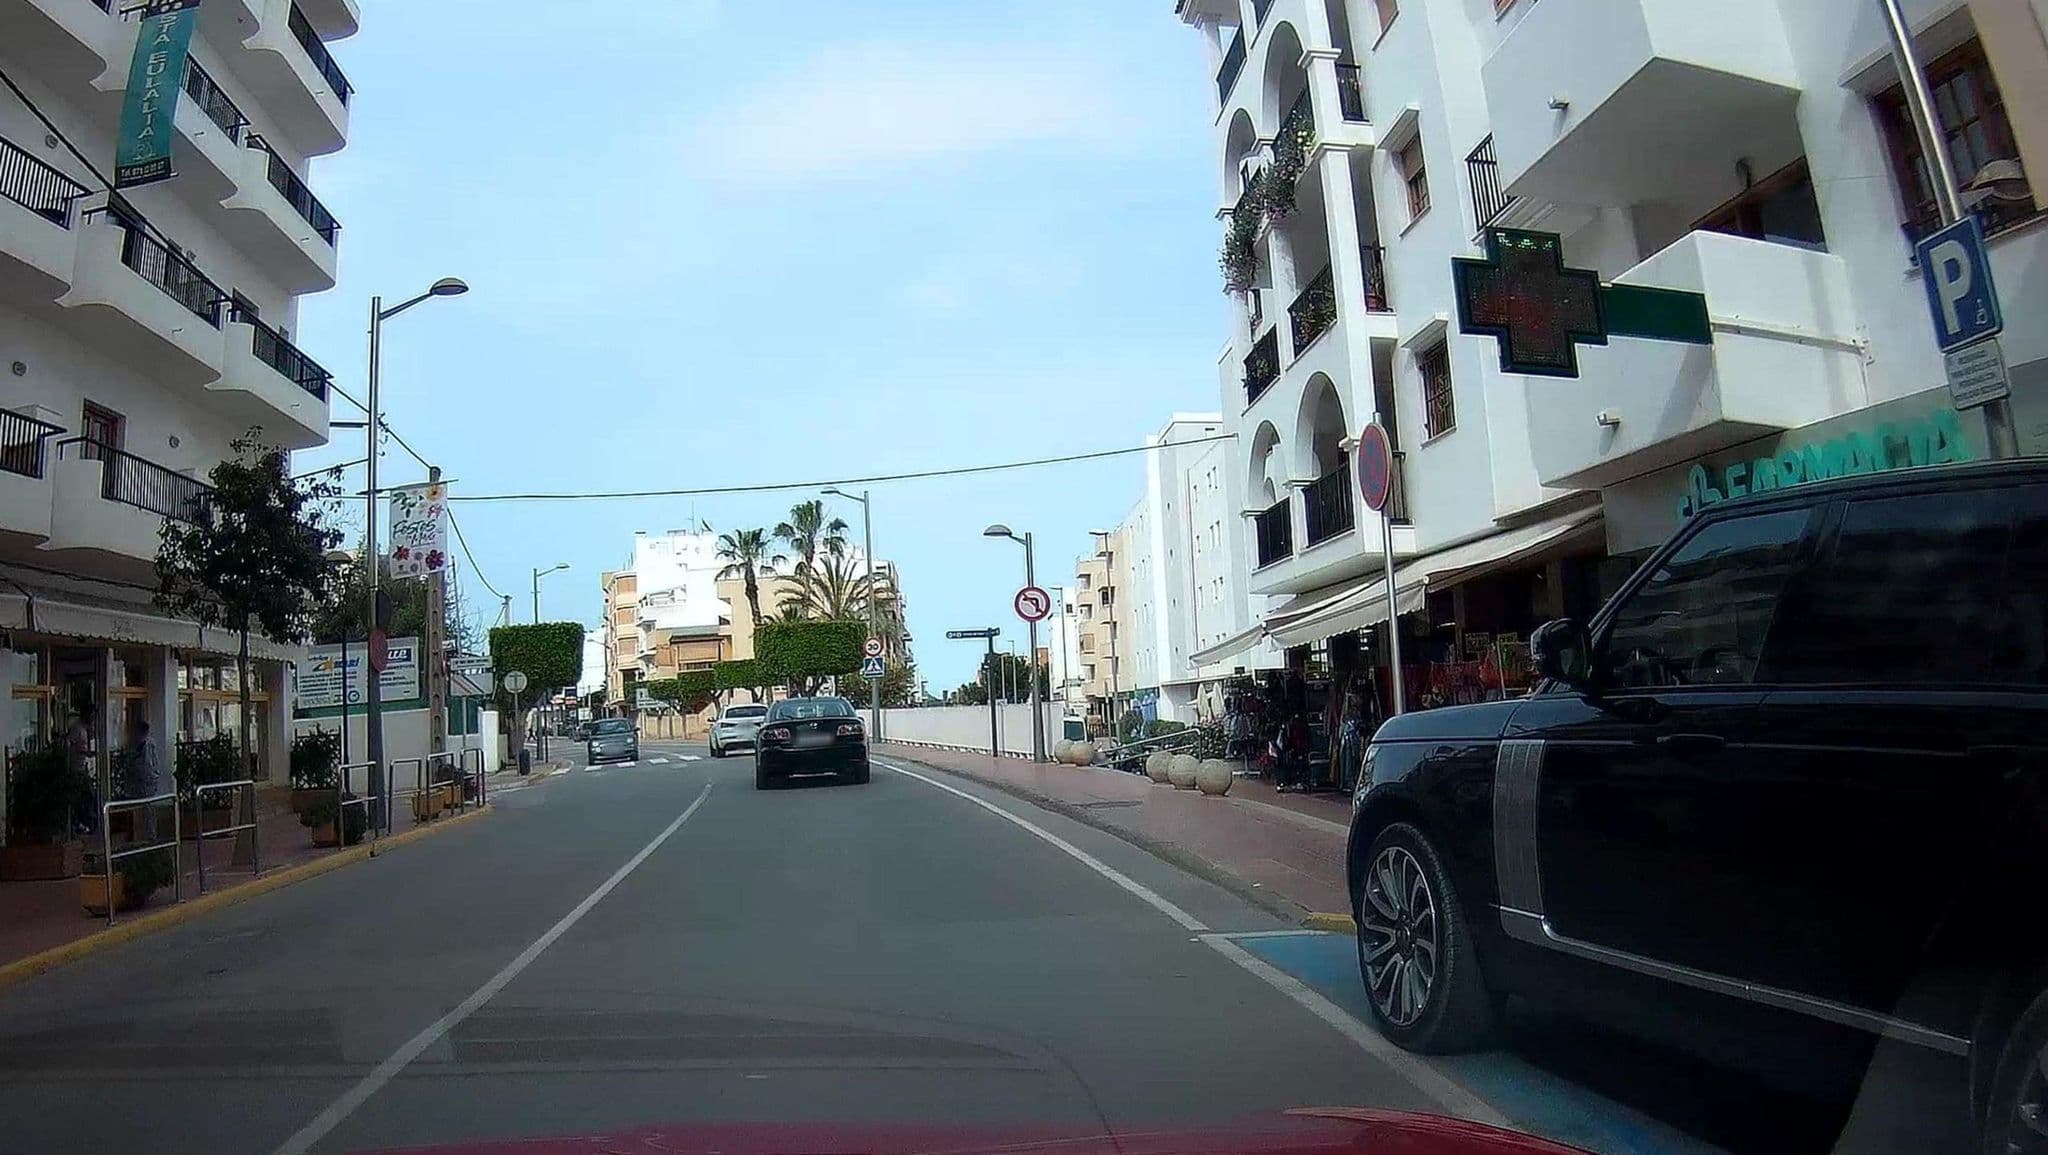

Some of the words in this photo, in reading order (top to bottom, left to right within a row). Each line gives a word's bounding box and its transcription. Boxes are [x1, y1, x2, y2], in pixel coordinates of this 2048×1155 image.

[137, 50, 169, 140] EULALIA
[1928, 239, 1973, 335] P
[867, 643, 880, 651] 30
